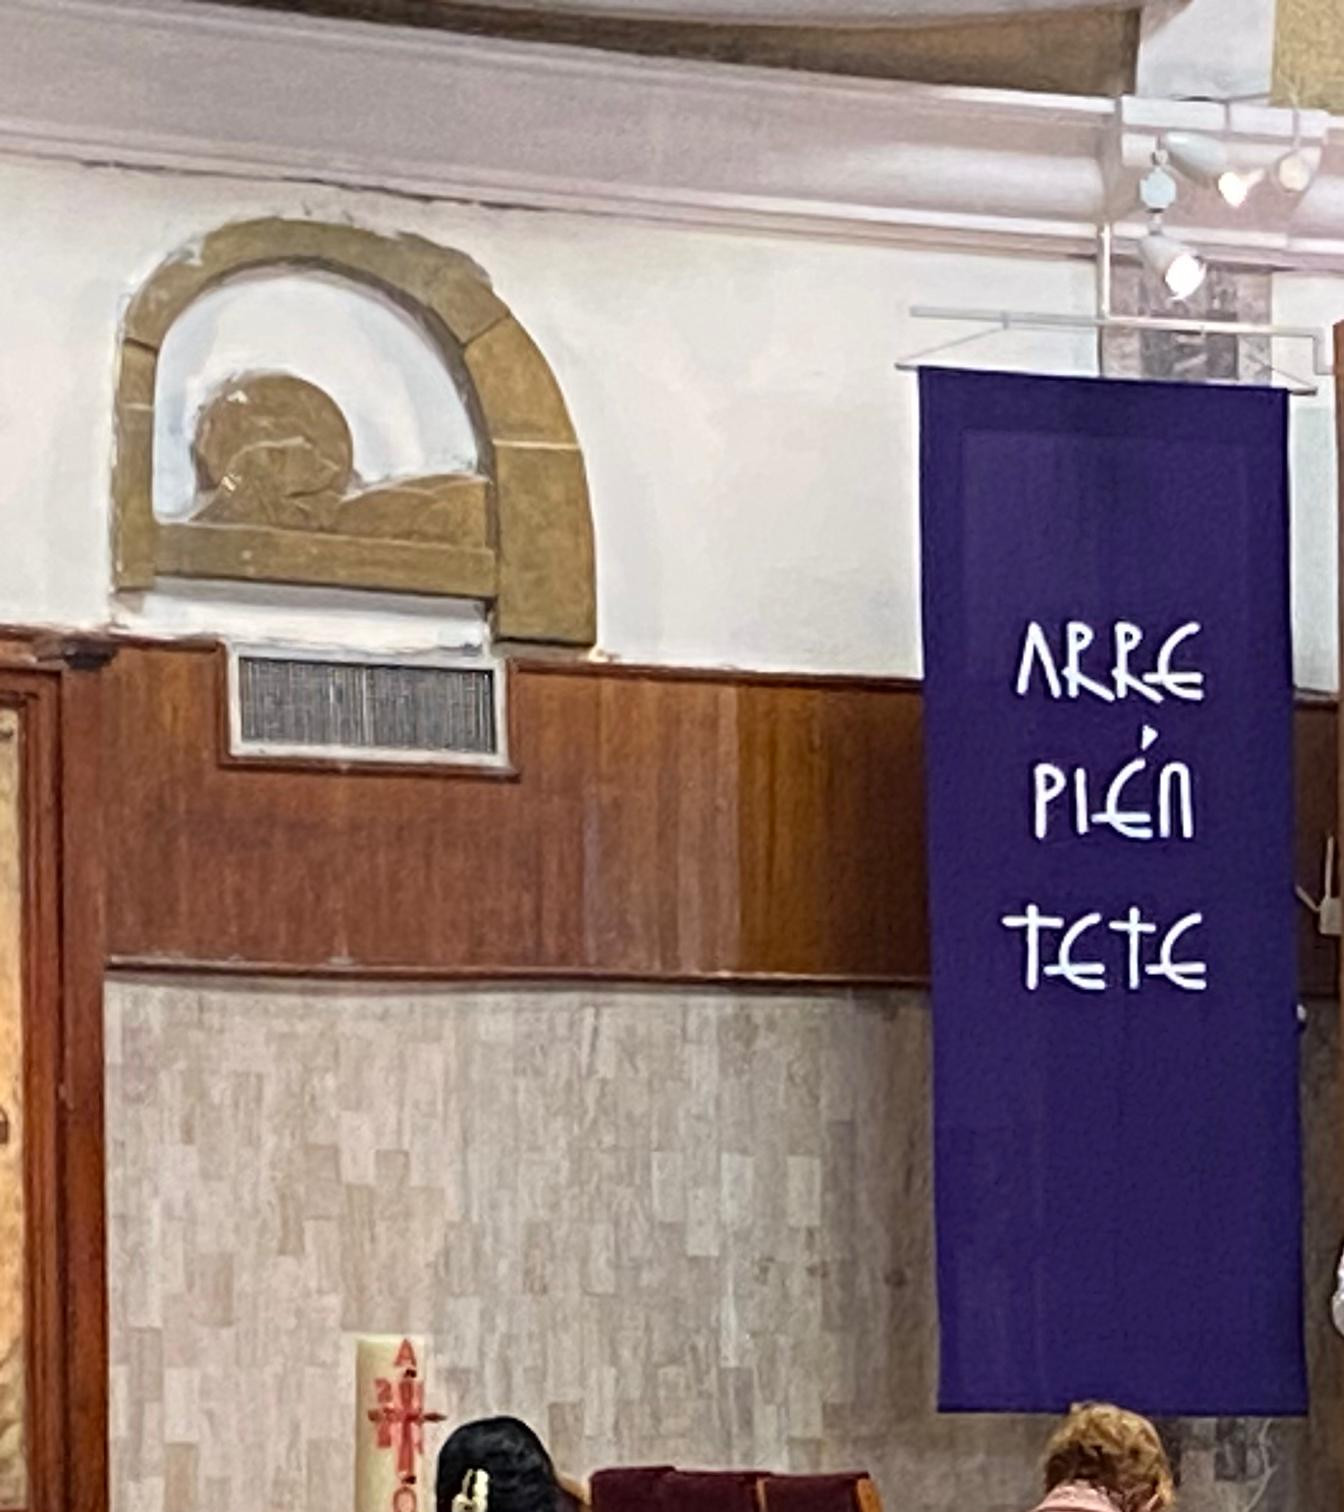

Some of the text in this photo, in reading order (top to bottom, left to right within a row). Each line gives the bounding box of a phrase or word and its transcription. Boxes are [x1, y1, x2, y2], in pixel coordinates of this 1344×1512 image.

[1016, 619, 1205, 703] ARRE
[1001, 904, 1207, 990] TETE
[394, 1338, 417, 1368] A
